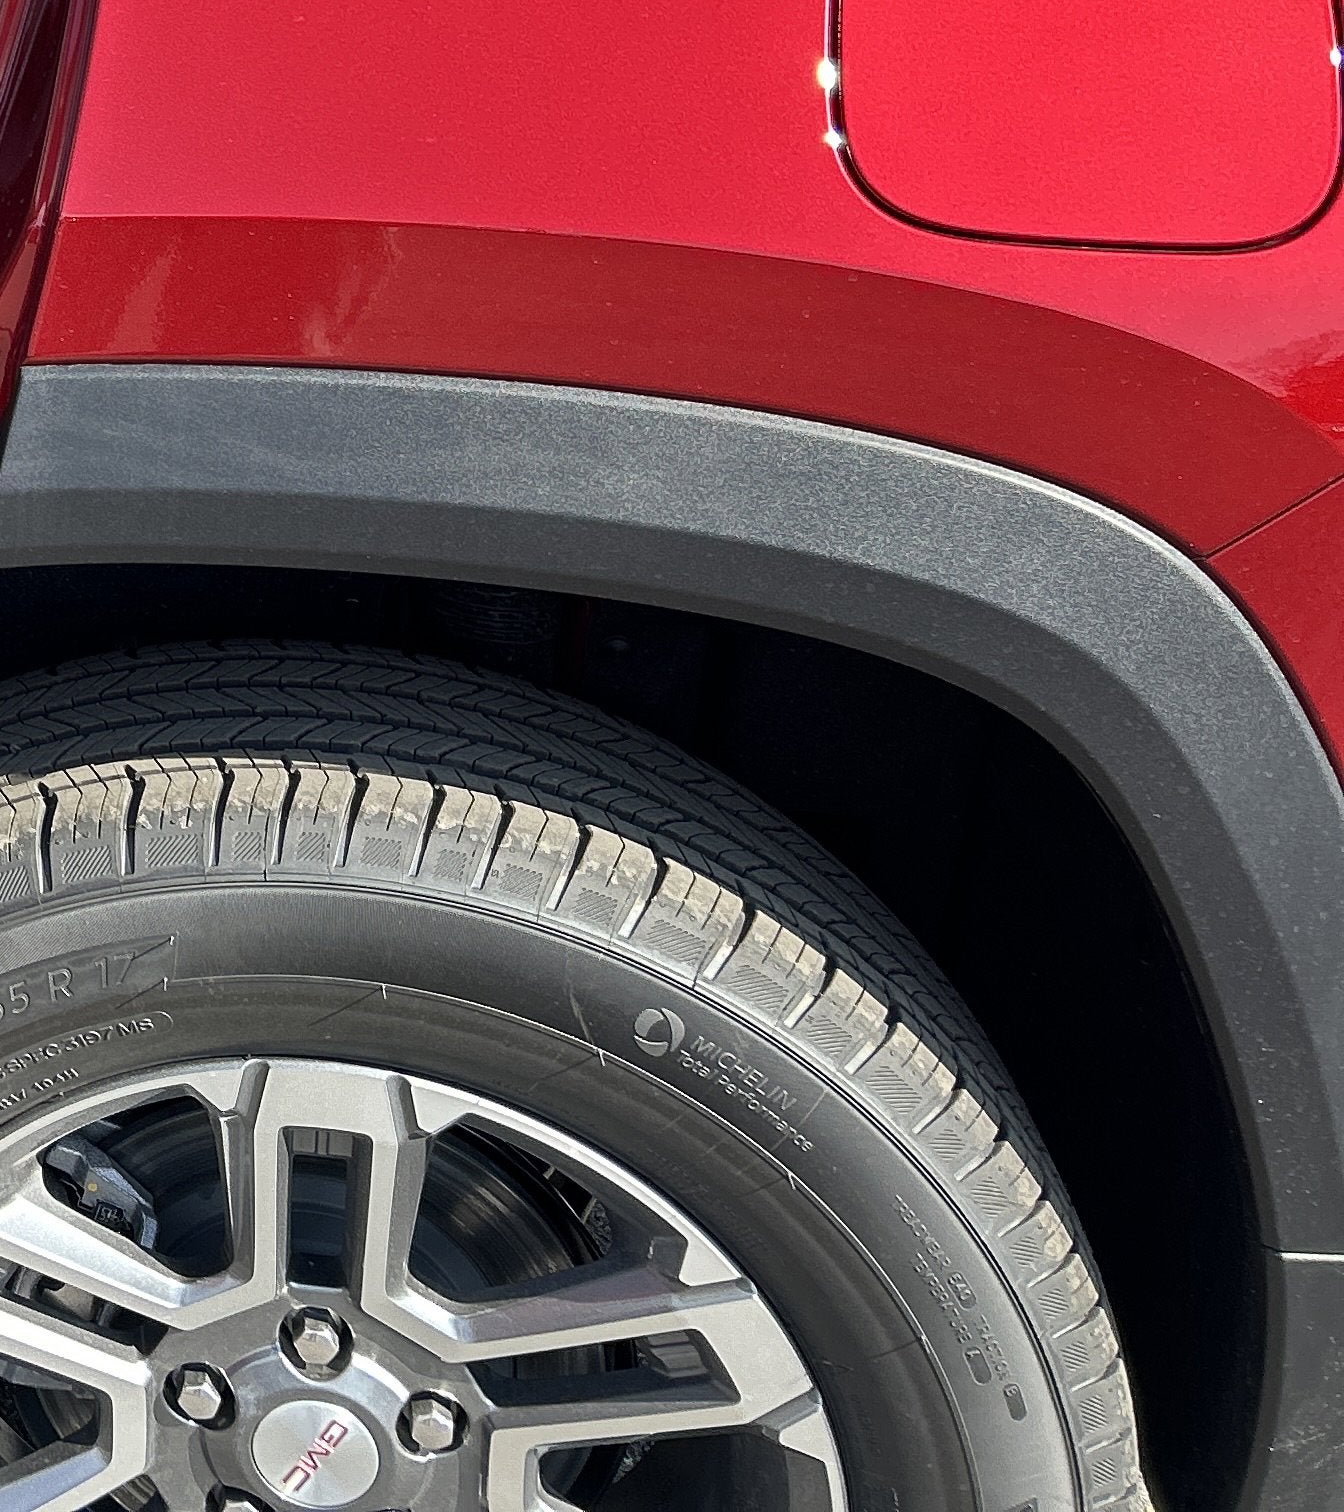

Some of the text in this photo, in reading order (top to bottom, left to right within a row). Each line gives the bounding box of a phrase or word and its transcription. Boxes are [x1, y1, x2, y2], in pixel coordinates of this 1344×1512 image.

[47, 968, 74, 1002] R
[94, 951, 136, 988] 17
[116, 1017, 156, 1037] MS
[676, 1048, 815, 1153] Total Performance
[689, 1035, 798, 1111] MICHELIN
[280, 1418, 349, 1492] GMC
